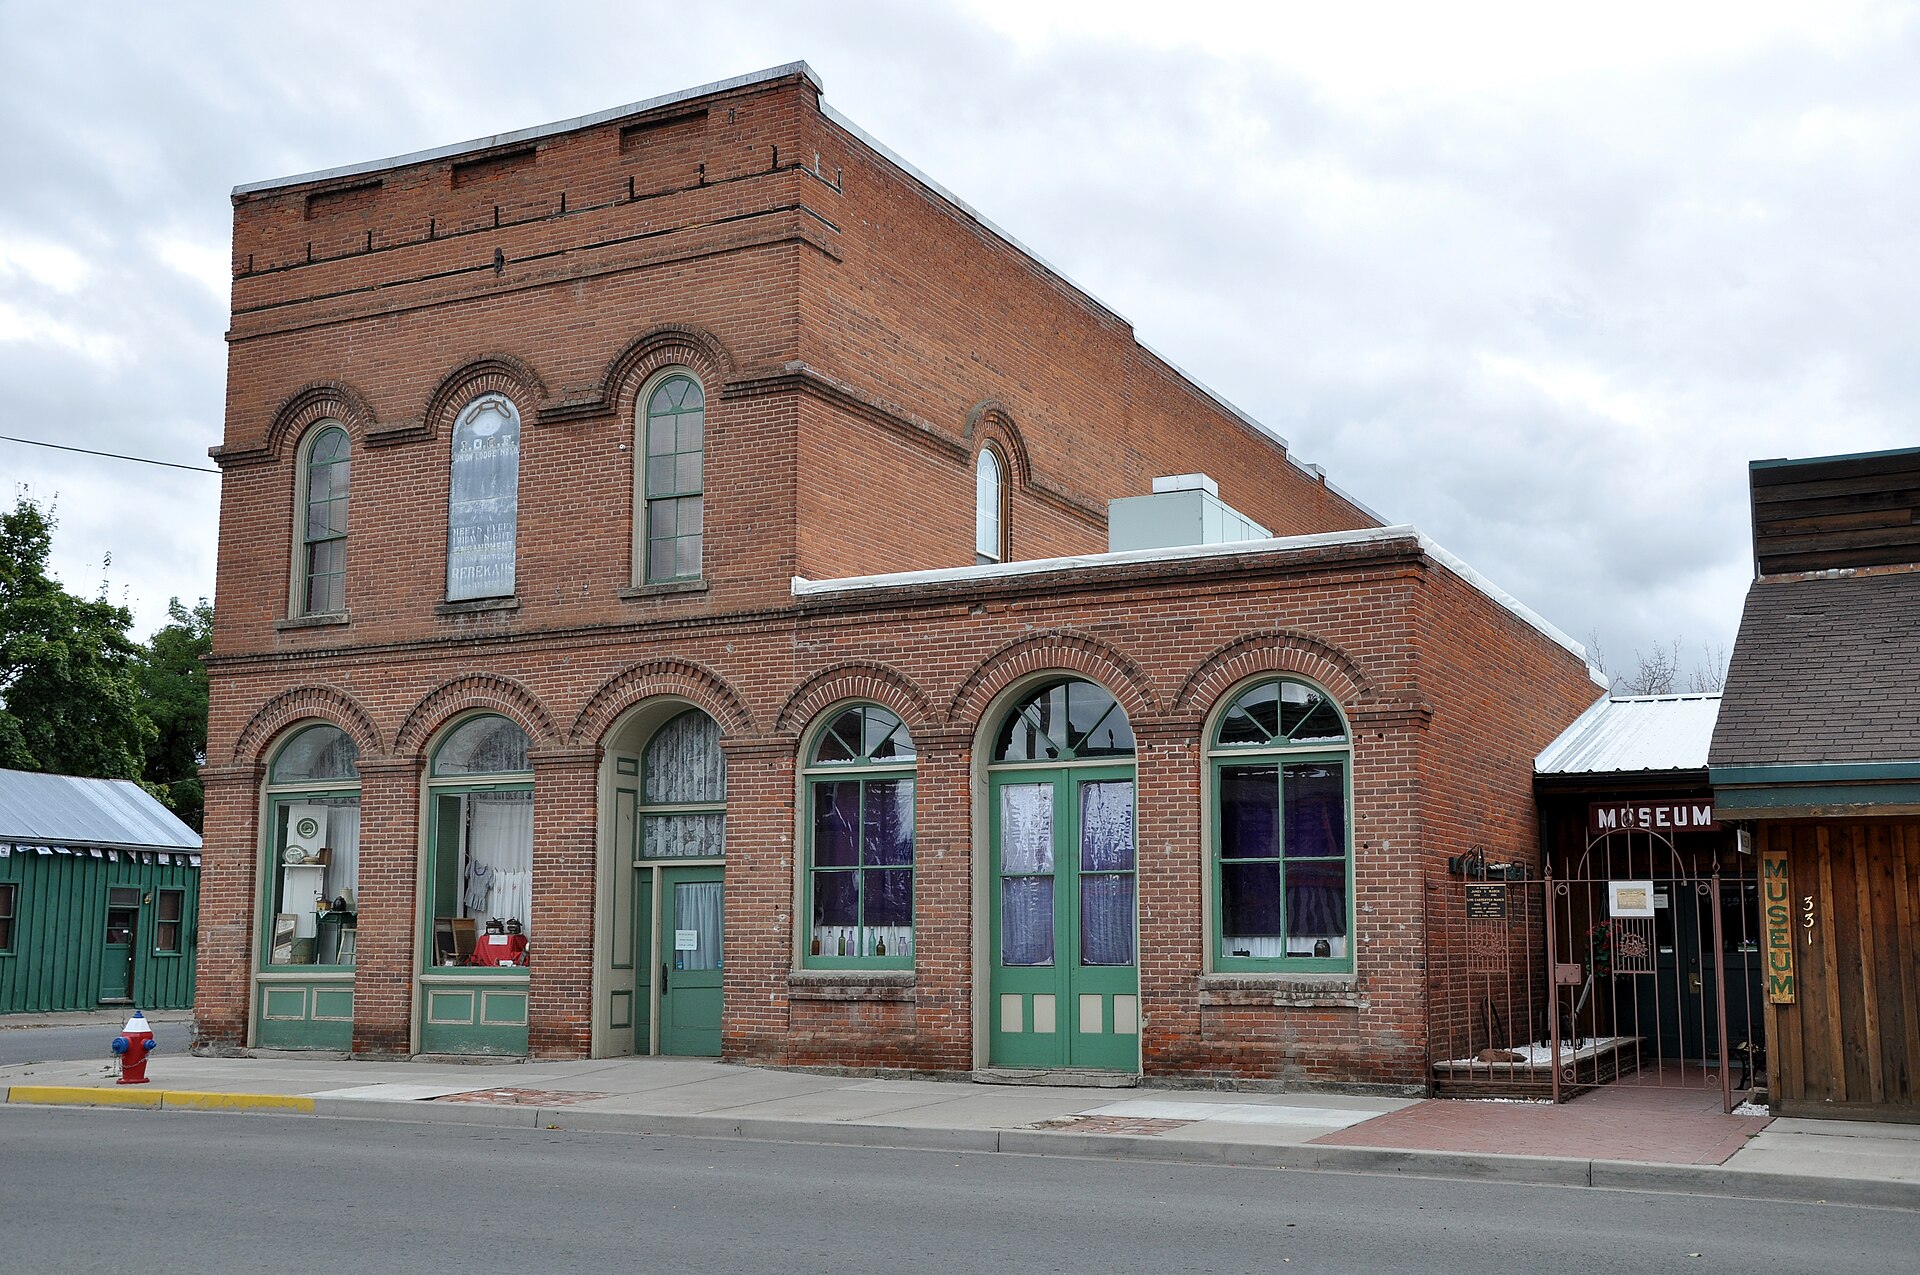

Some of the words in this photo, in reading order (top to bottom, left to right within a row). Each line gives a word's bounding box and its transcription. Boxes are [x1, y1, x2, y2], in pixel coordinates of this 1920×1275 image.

[1598, 805, 1711, 828] MUSEUM
[1764, 859, 1794, 995] MUSEUM
[1803, 896, 1815, 945] 331
